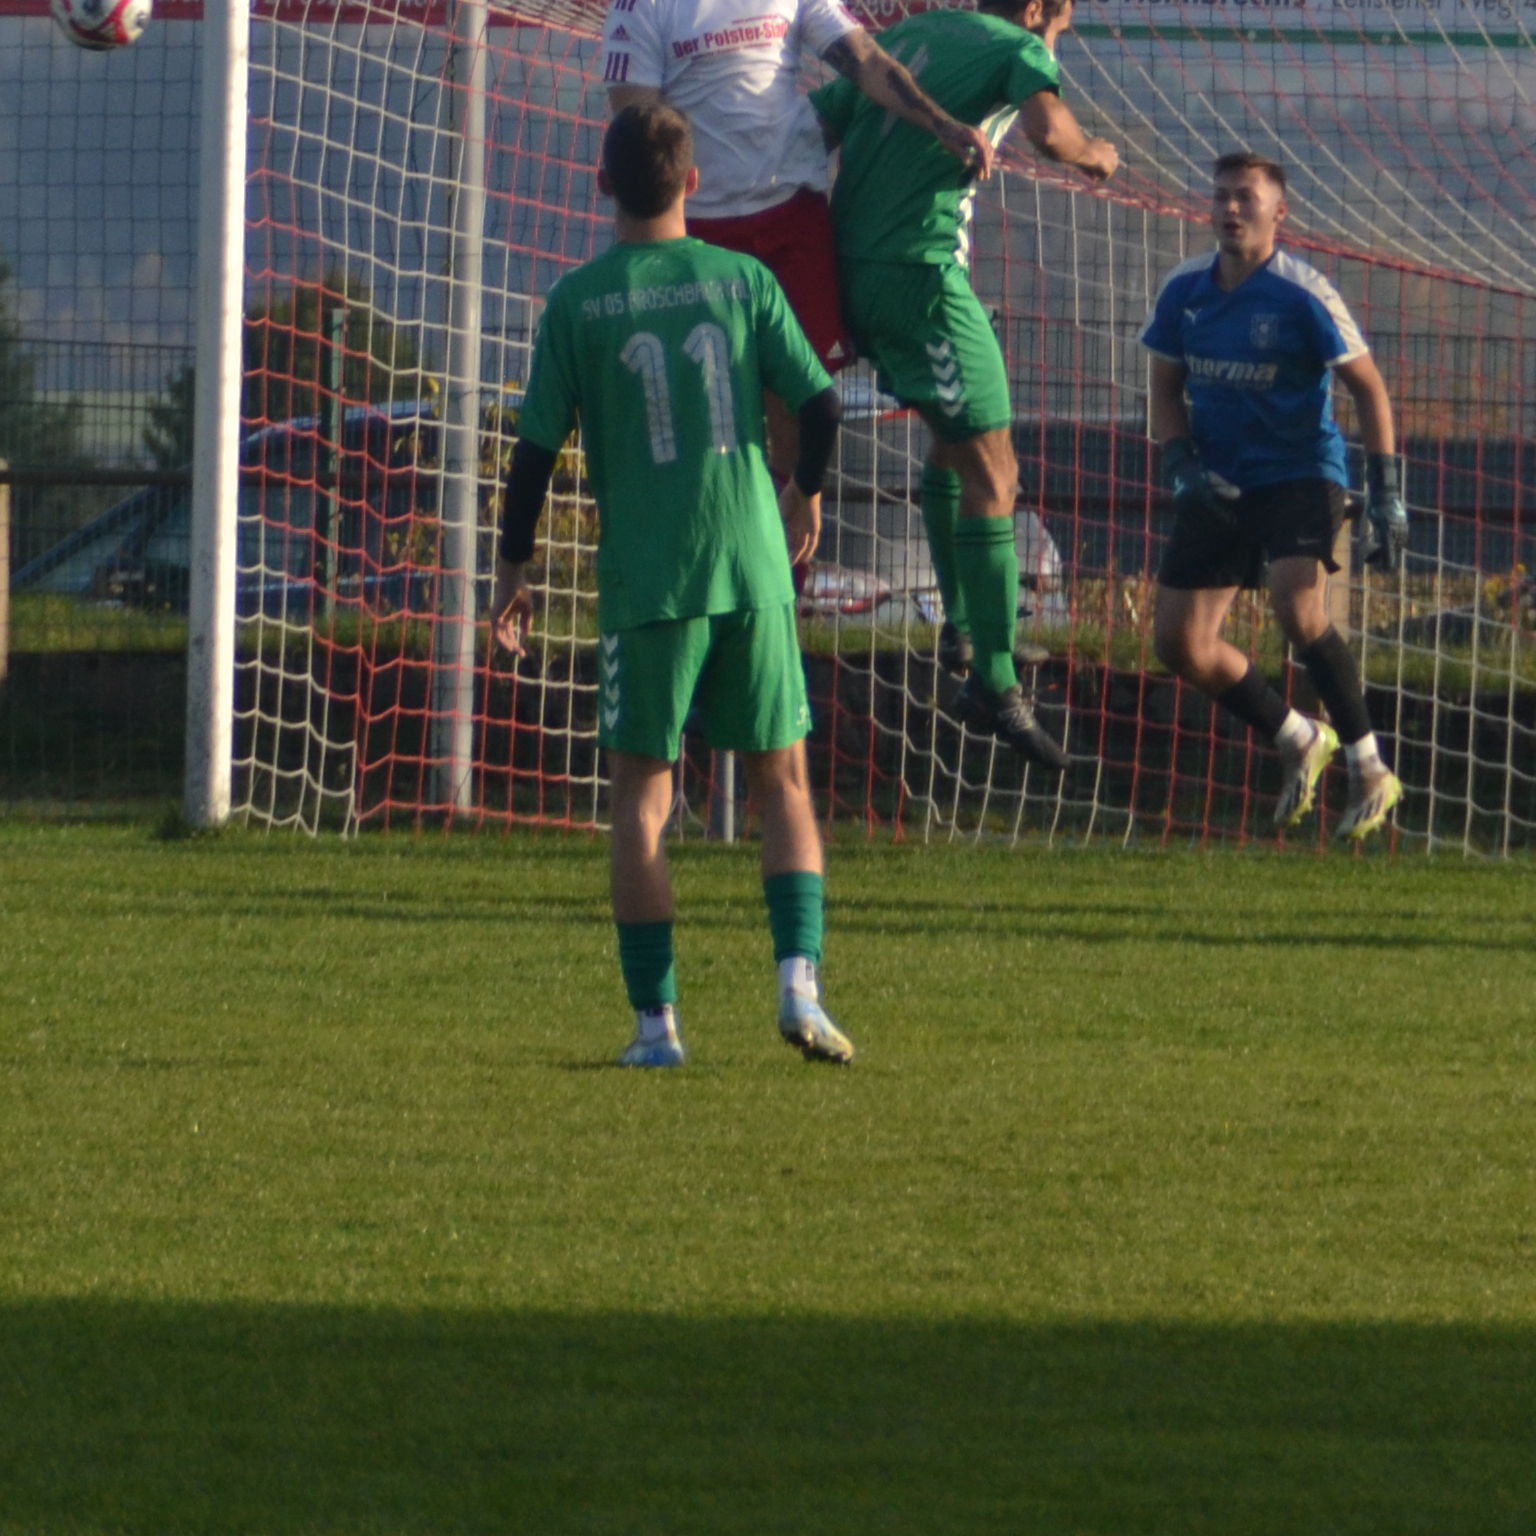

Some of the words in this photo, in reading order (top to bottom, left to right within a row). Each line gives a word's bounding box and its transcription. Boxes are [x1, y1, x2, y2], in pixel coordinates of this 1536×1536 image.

[671, 35, 701, 59] Der
[582, 296, 602, 321] SV
[619, 321, 737, 464] 11
